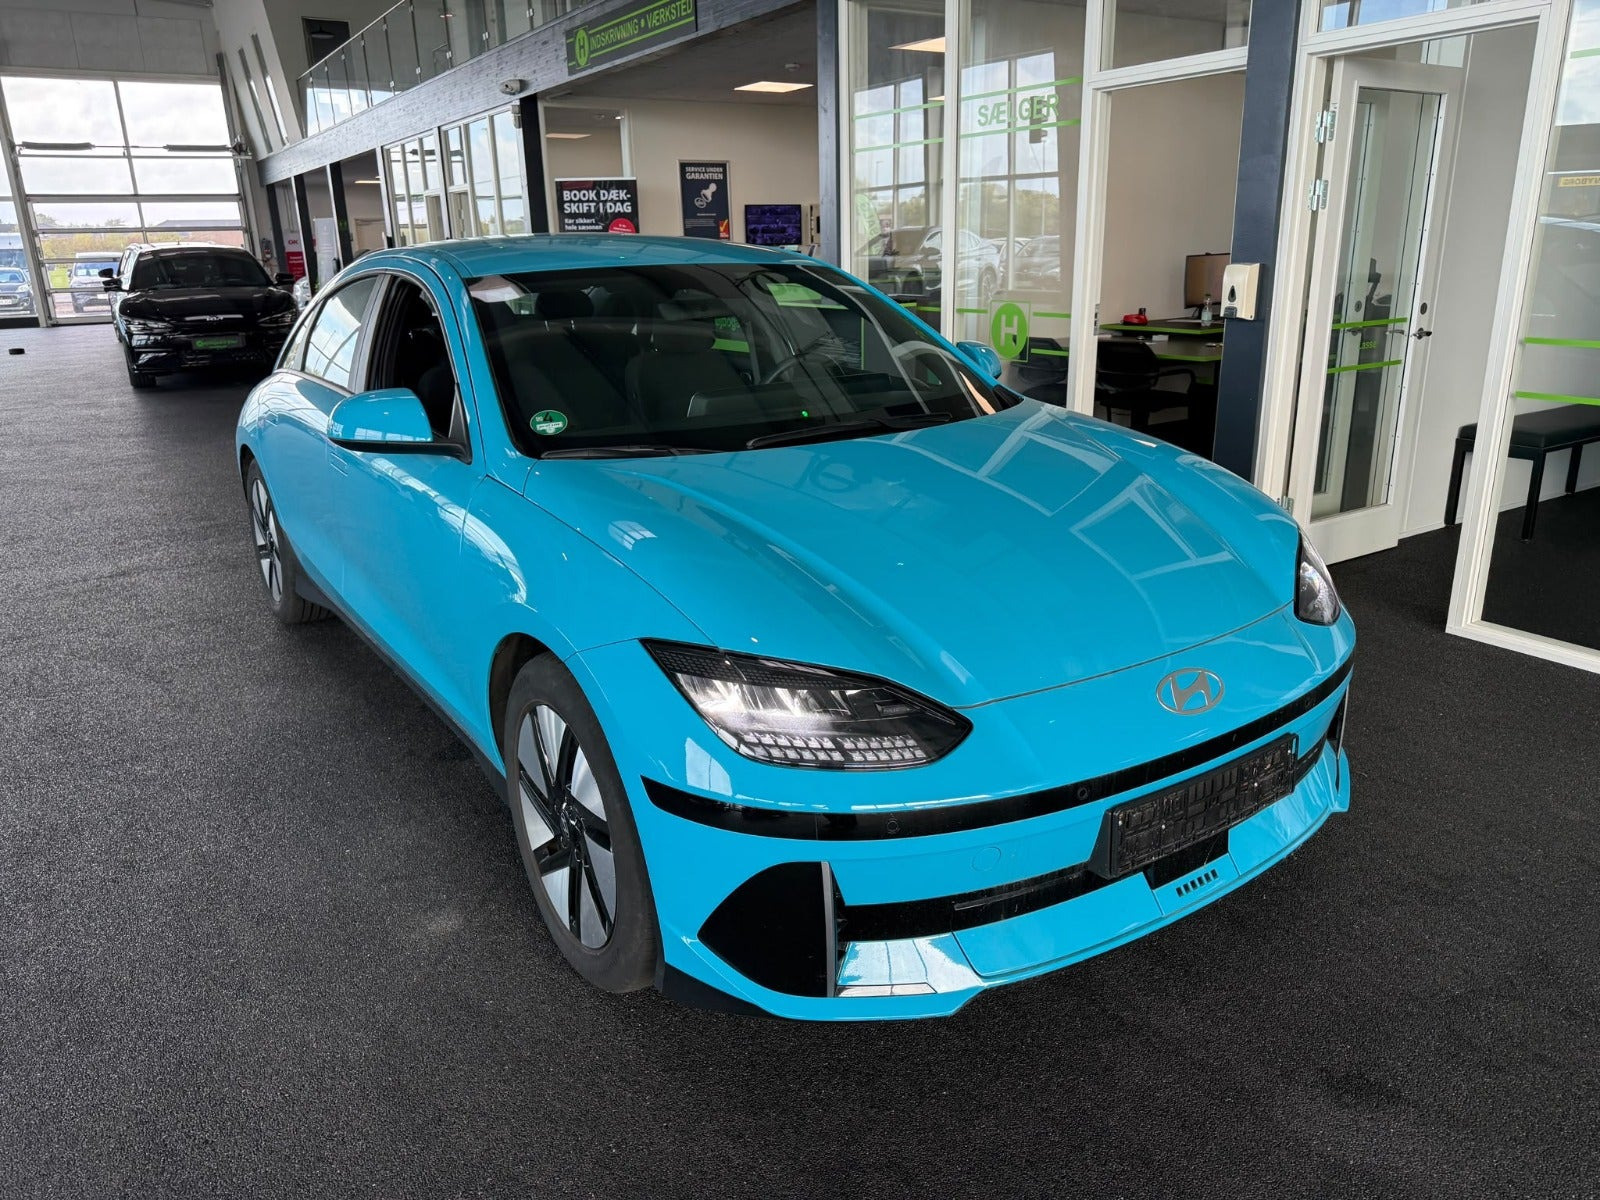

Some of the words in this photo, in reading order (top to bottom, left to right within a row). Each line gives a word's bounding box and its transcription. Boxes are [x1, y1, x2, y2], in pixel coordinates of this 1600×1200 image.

[589, 19, 639, 50] INDSKRIVNING
[646, 0, 693, 29] VÆRKSTED
[977, 94, 1059, 126] SÆLGER
[563, 190, 597, 201] BOOK
[600, 189, 631, 200] DÆK-
[564, 202, 596, 213] SKIFT
[606, 202, 632, 213] DAG
